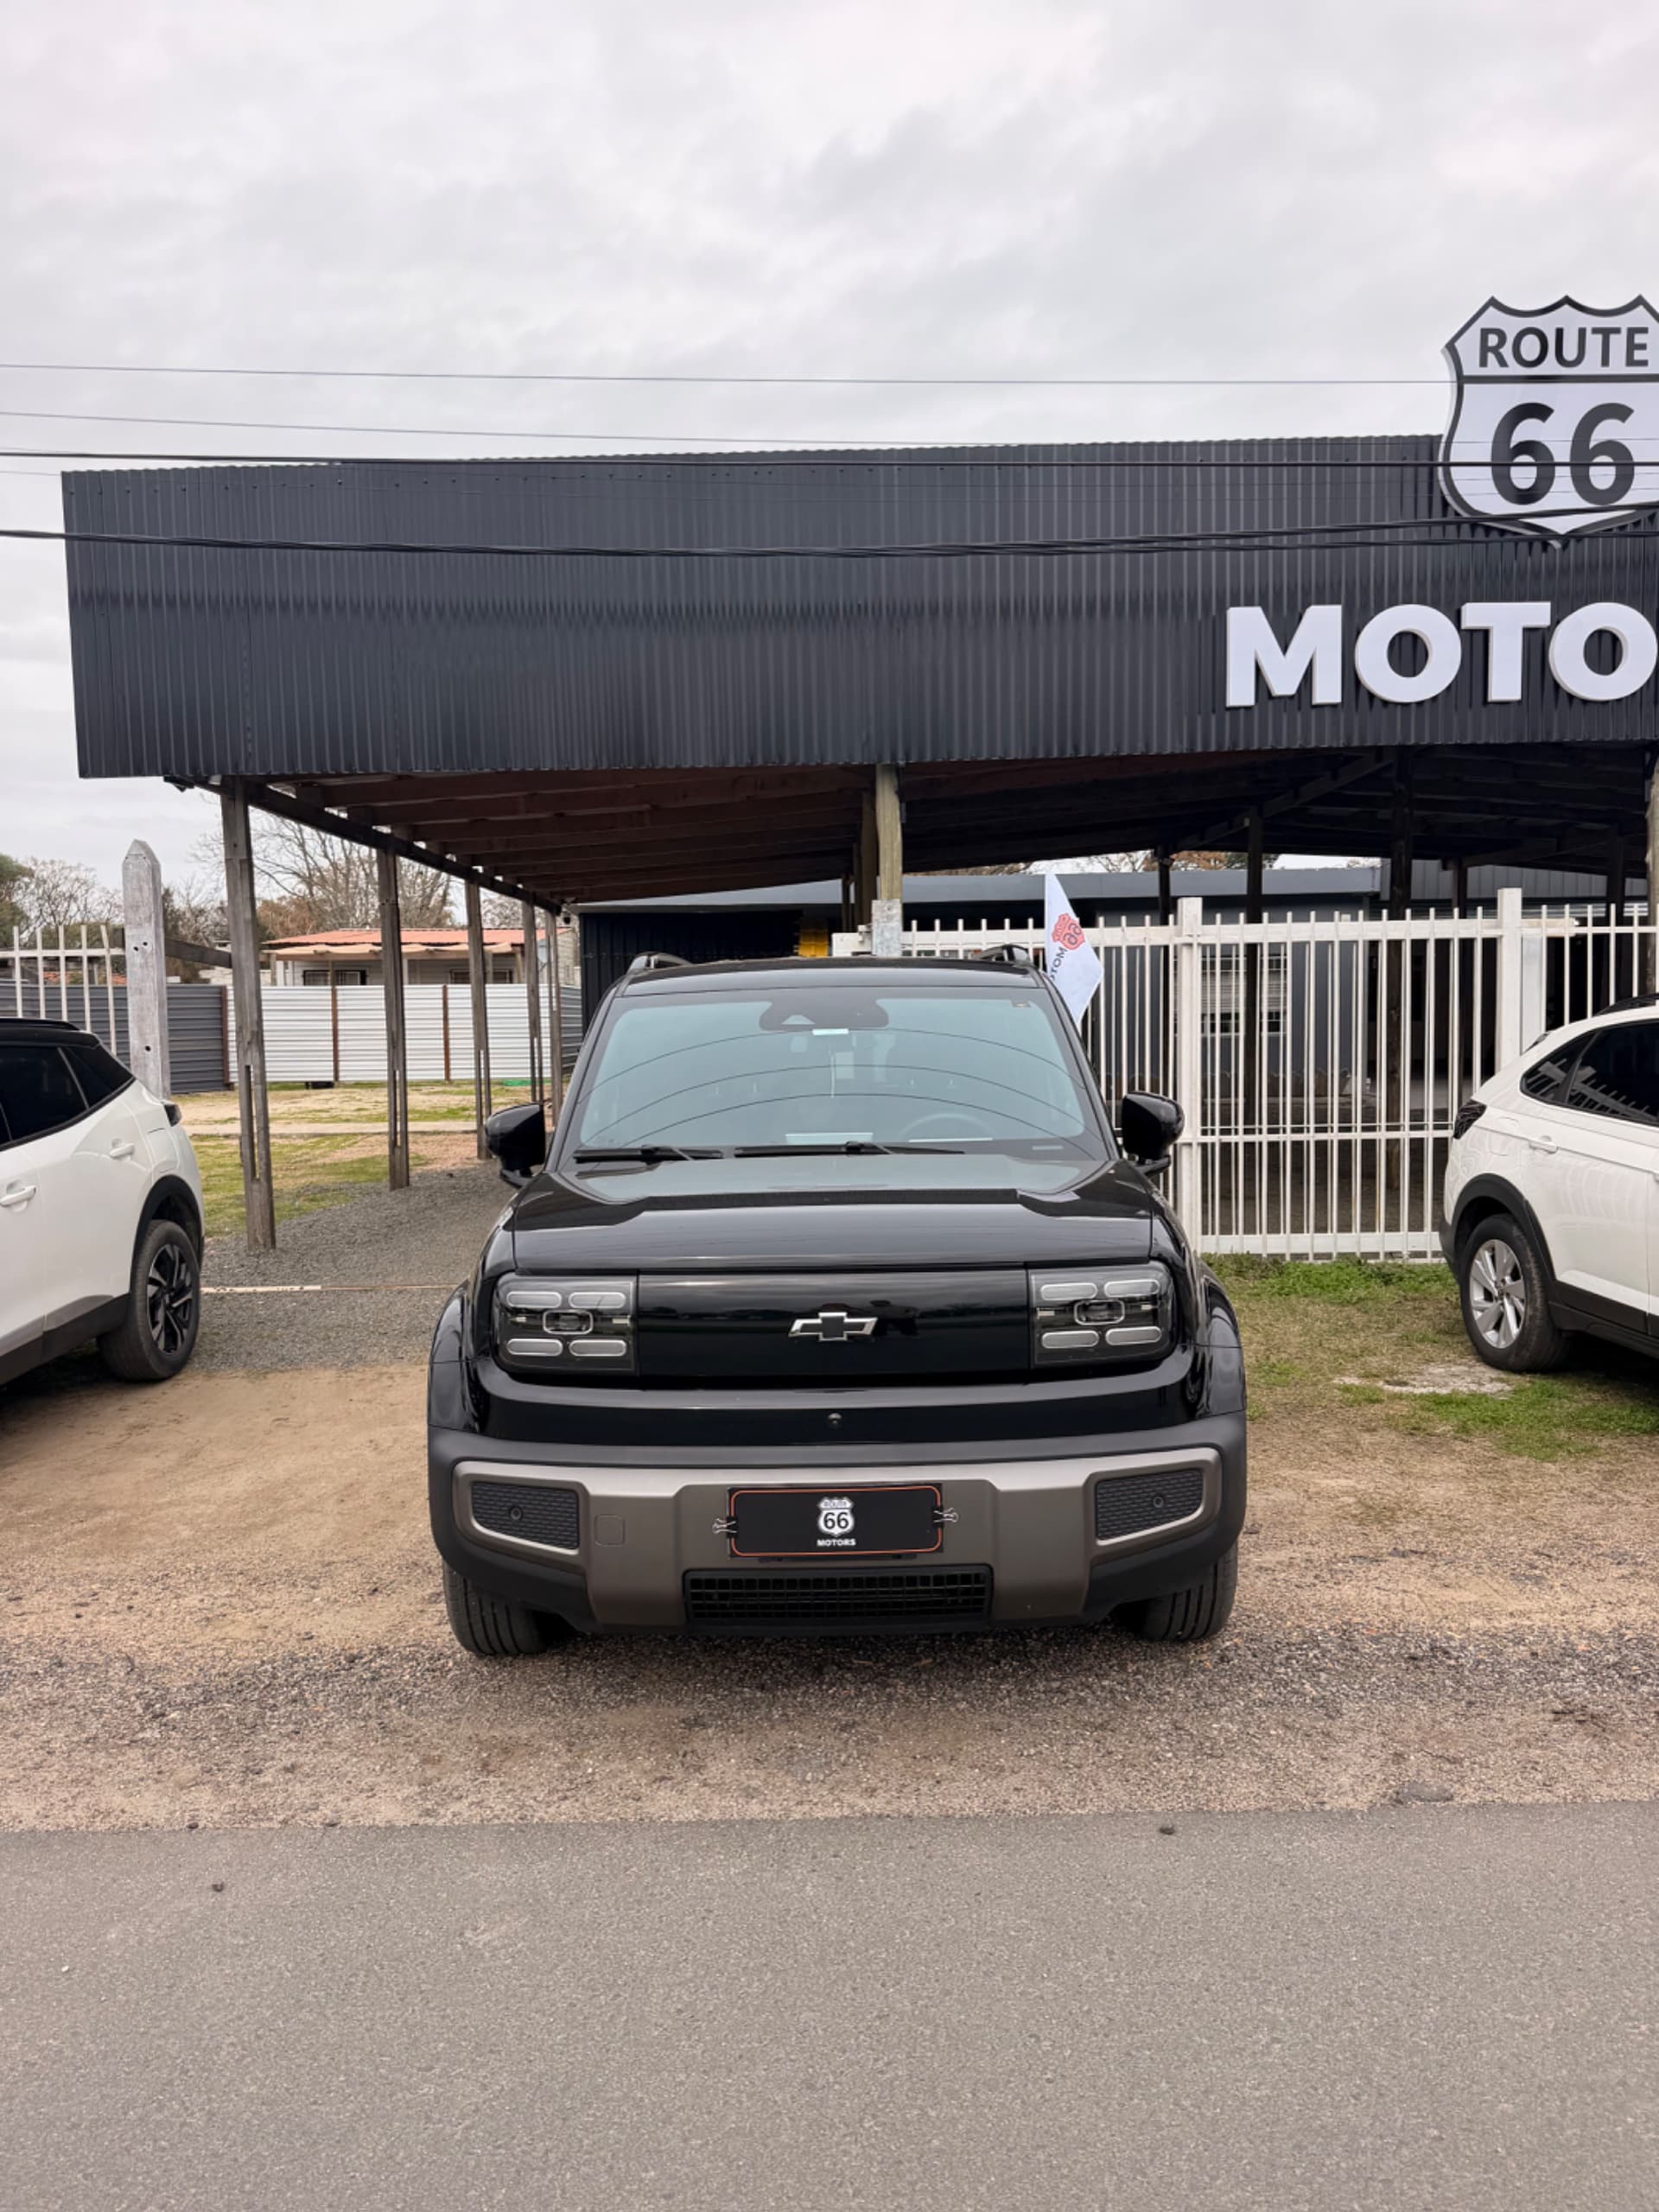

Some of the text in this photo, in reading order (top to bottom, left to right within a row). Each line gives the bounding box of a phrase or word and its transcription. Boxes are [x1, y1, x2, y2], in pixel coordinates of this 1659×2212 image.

[1478, 327, 1649, 369] ROUTE
[1491, 402, 1636, 505] 66
[1226, 601, 1658, 708] MOTO
[823, 1512, 849, 1529] 66
[817, 1538, 856, 1547] MOTORS
